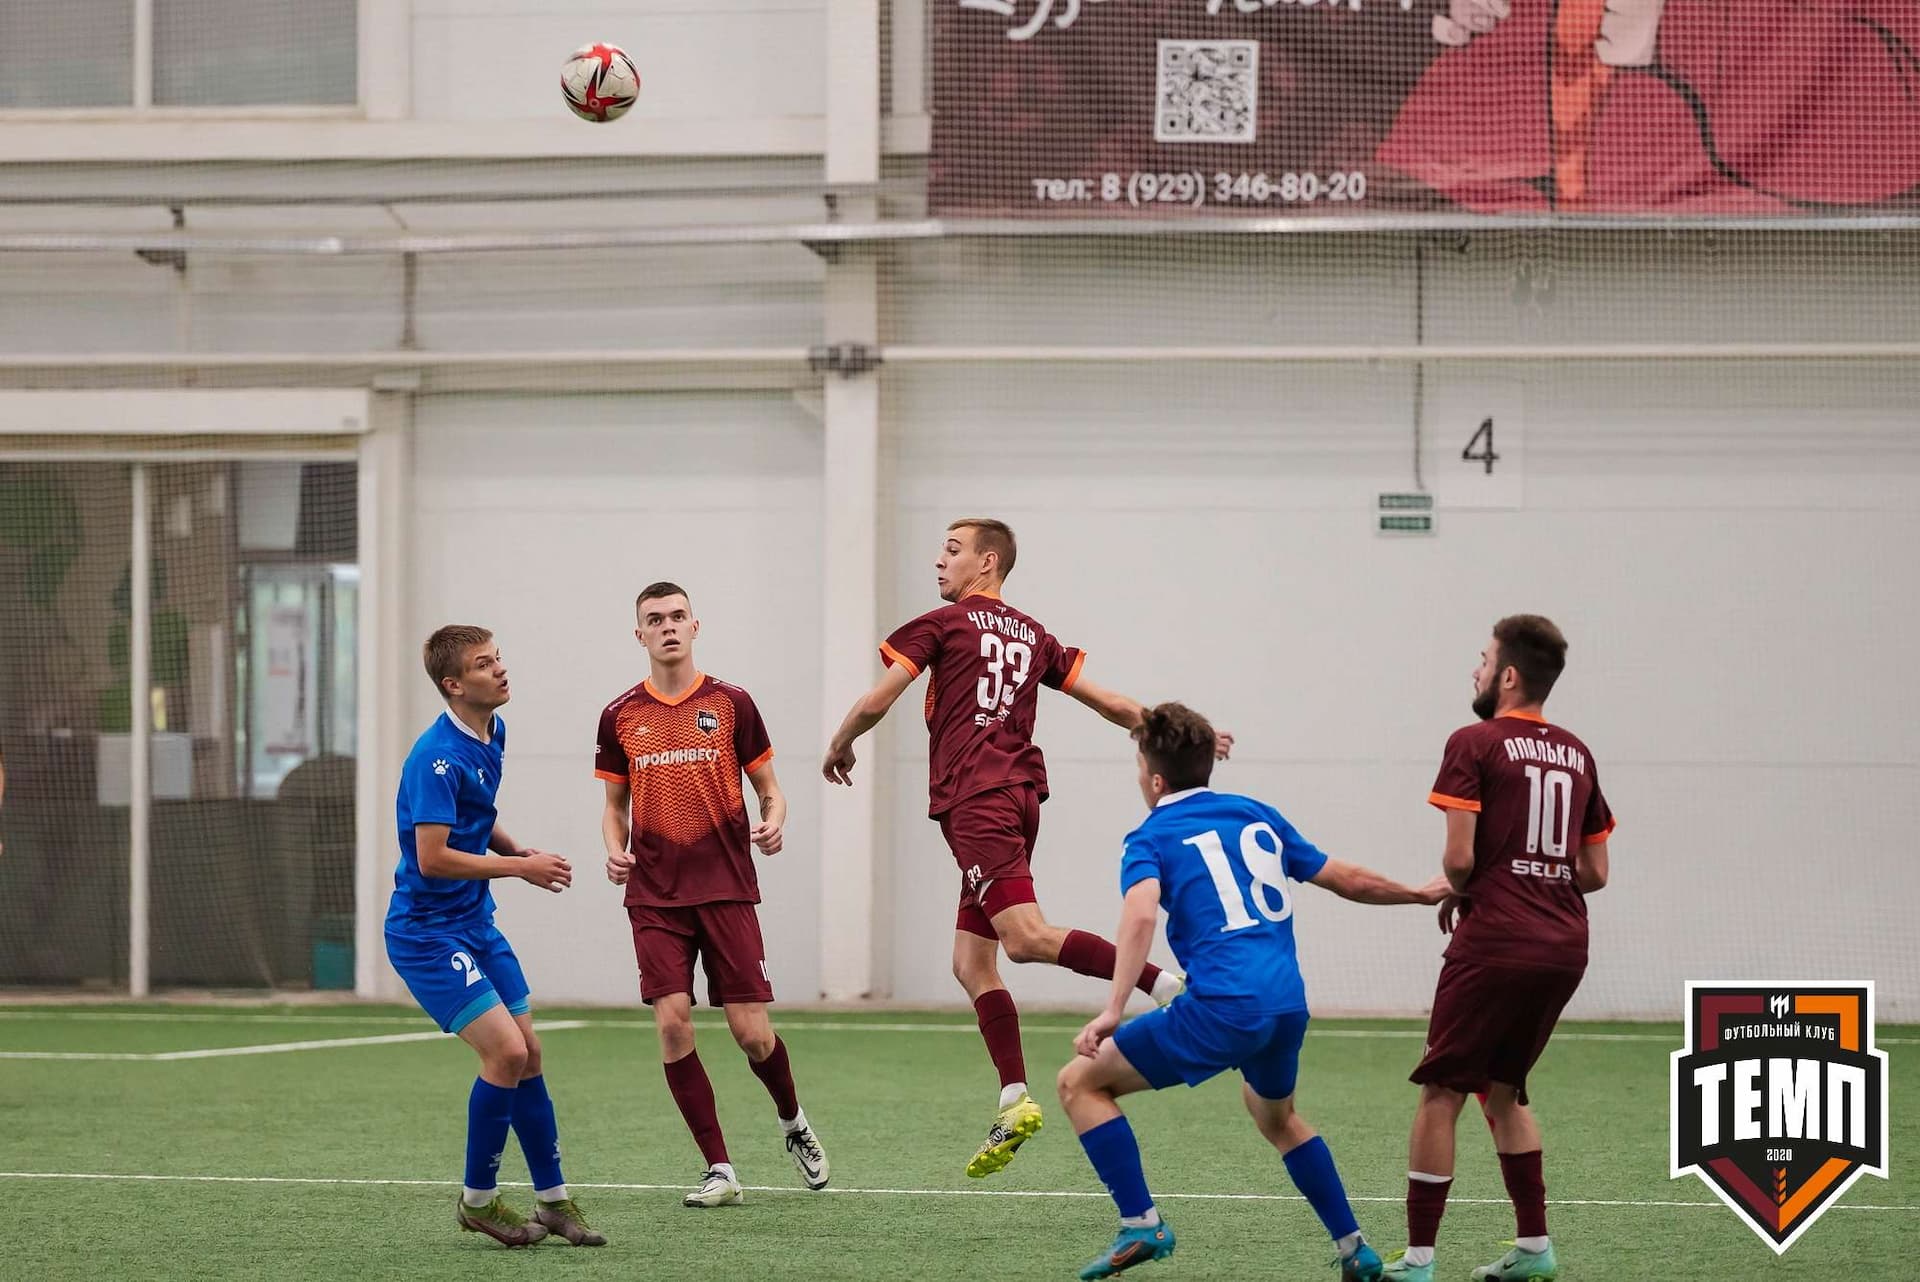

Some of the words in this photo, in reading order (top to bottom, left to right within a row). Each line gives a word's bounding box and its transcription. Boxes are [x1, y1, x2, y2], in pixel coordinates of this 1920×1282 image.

[1032, 178, 1095, 201] тел:
[1102, 172, 1121, 201] 8
[1127, 170, 1205, 208] (929)
[1213, 171, 1366, 202] 346-80-20
[1462, 417, 1500, 474] 4
[976, 632, 1032, 711] 33
[634, 747, 720, 771] ПРОДИНВЕСТ
[1503, 736, 1586, 776] АПАЛЬКИН
[1524, 764, 1573, 859] 10
[1181, 821, 1292, 933] 18
[1511, 858, 1572, 882] SEUS
[450, 951, 487, 988] 2
